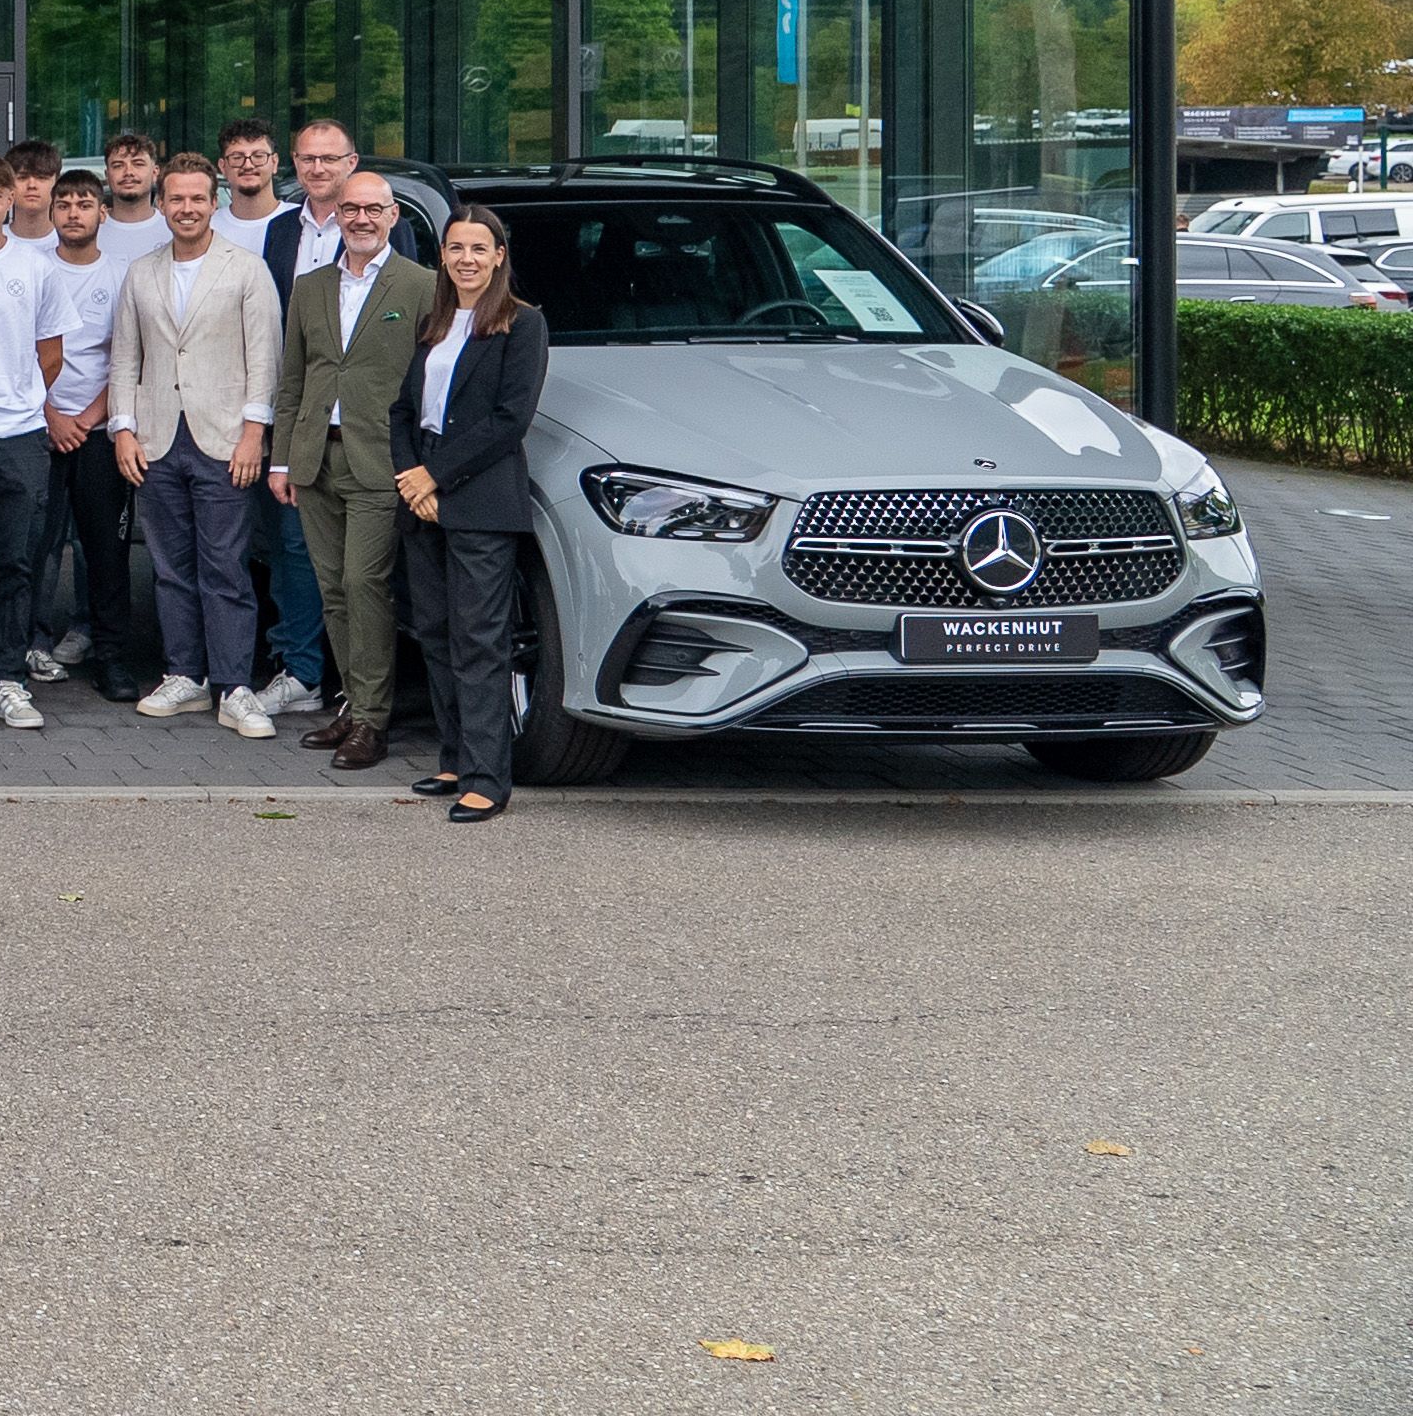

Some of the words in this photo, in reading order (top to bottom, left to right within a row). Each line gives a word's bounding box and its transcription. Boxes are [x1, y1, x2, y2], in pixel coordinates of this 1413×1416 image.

[942, 620, 1064, 636] WACKENHUT
[946, 643, 1011, 653] PERFECT
[1017, 642, 1061, 653] DRIVE
